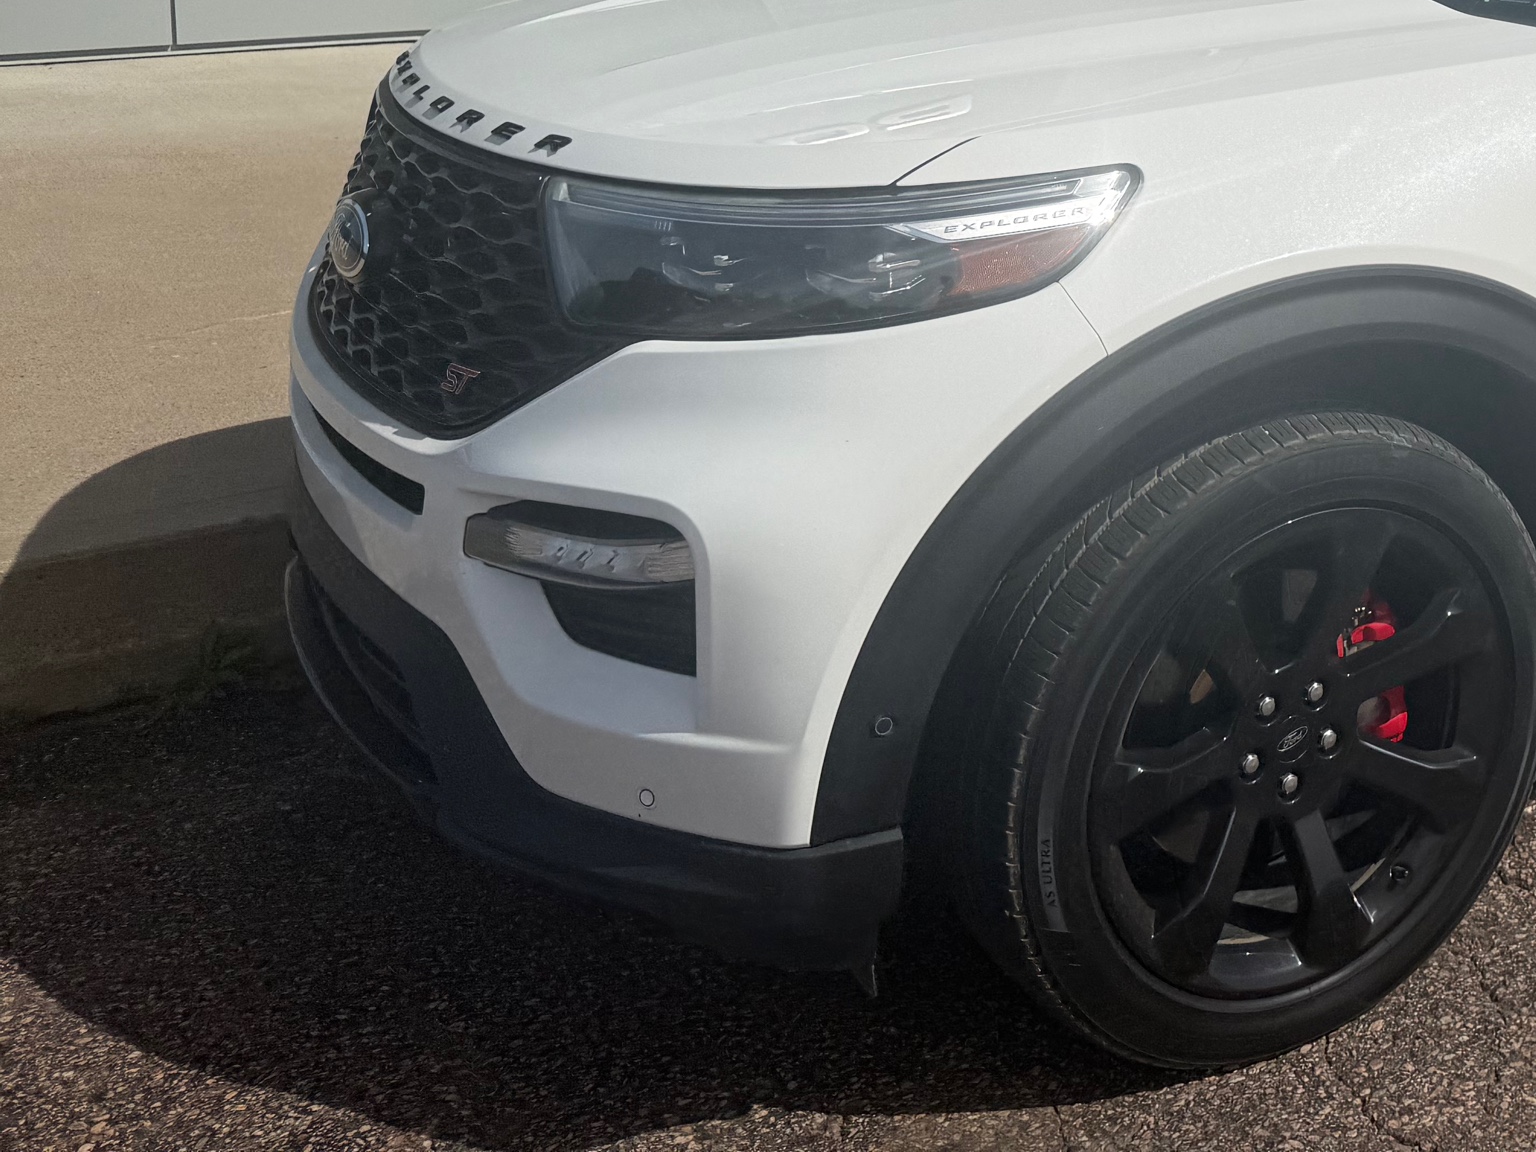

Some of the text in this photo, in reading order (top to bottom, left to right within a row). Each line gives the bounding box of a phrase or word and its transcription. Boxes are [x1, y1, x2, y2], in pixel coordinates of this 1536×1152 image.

[943, 206, 1086, 235] EXPLORER
[440, 362, 481, 395] ST
[1040, 839, 1058, 908] AS ULTRA
